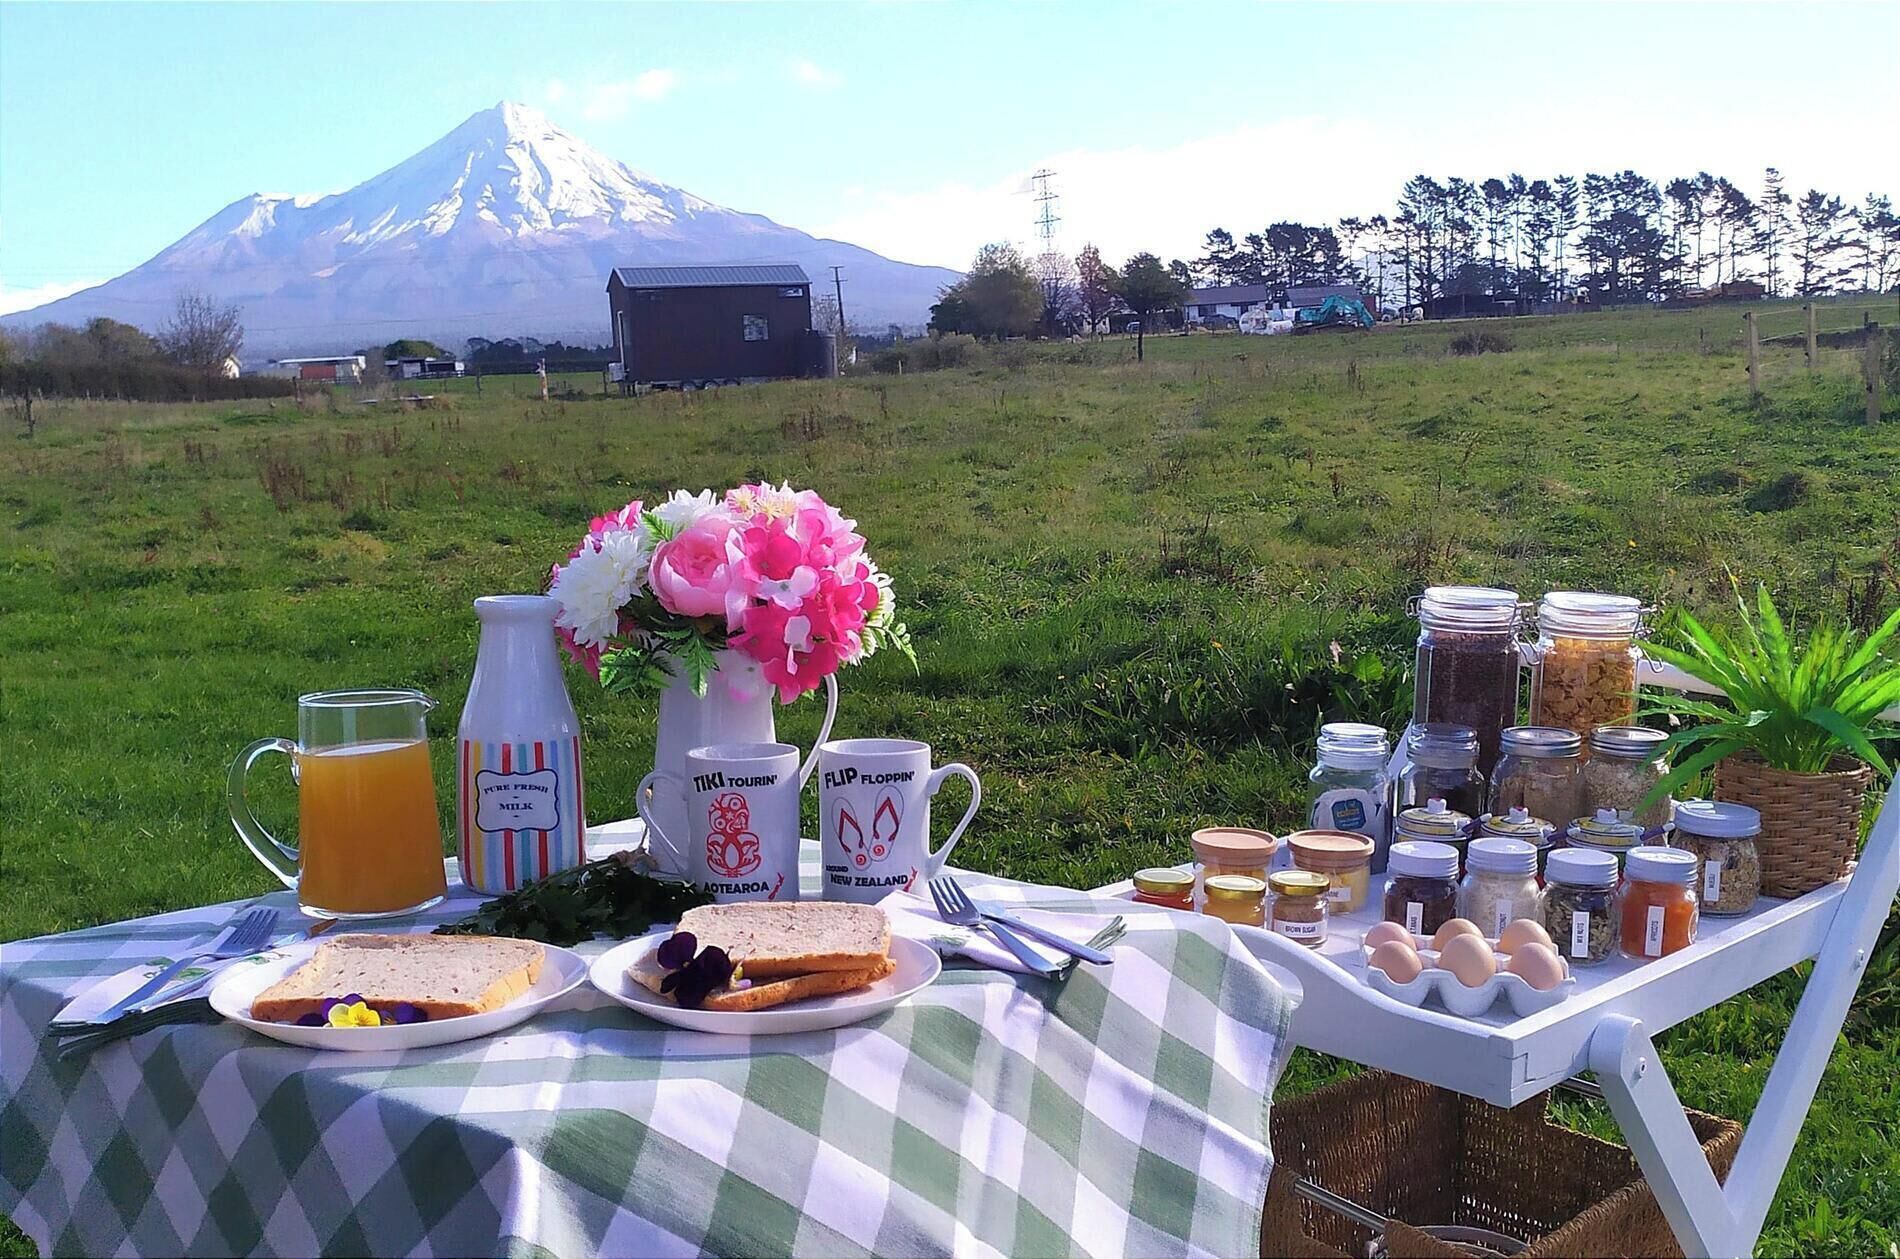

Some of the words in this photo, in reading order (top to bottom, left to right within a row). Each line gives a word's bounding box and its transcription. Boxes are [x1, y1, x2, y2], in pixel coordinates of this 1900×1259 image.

[693, 771, 725, 792] TIKI
[727, 774, 778, 787] TOURIN'
[824, 767, 858, 789] FLIP
[860, 771, 915, 785] FLOPPIN'
[483, 784, 510, 795] PURE
[513, 784, 549, 794] FRESH
[498, 802, 534, 811] MILK
[830, 873, 852, 887] NEW
[854, 874, 909, 887] ZEALAND
[703, 881, 770, 894] AOTEAROA
